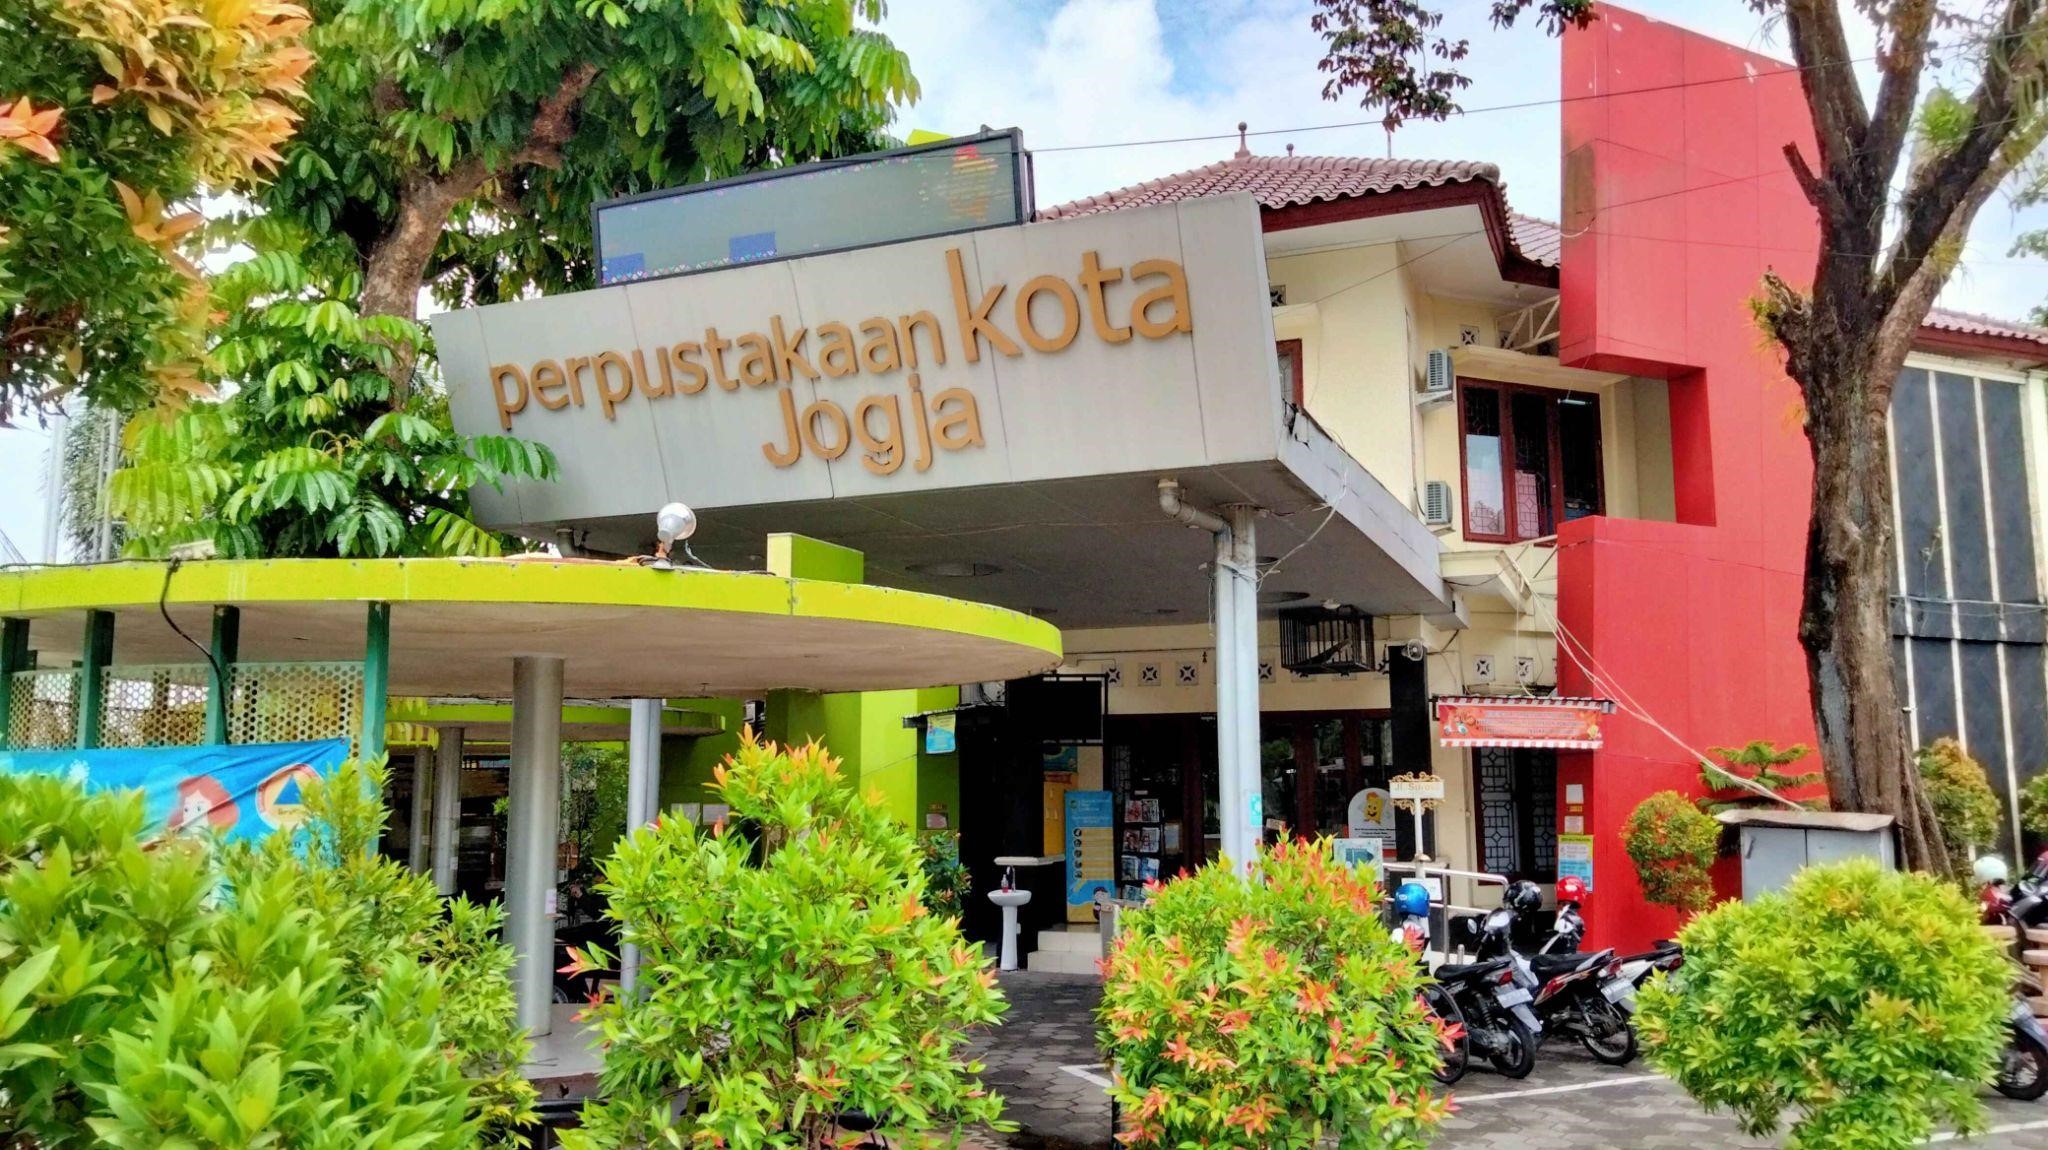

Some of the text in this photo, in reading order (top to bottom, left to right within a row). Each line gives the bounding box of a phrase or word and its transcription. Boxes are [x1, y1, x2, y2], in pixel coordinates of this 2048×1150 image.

[489, 247, 1194, 430] perpustakaan kota
[761, 371, 985, 476] Jogja
